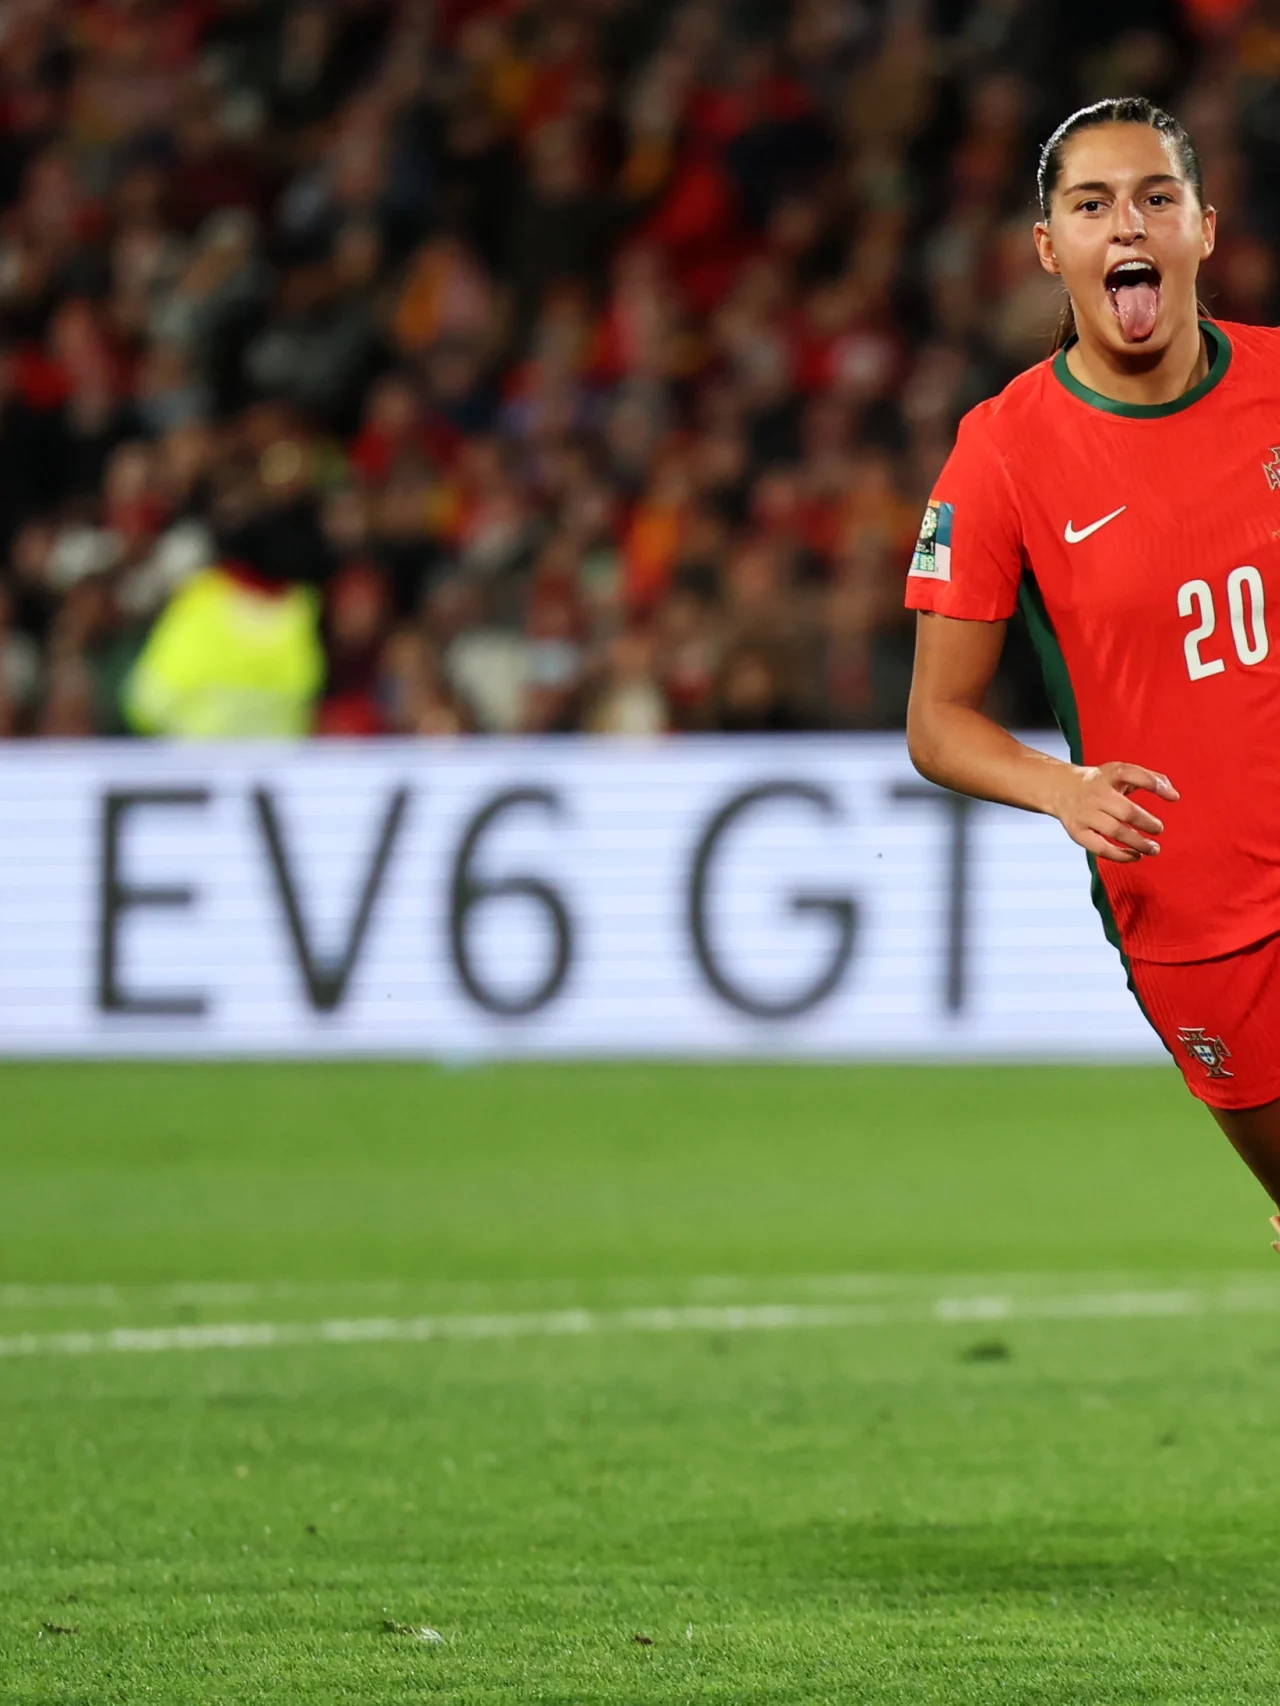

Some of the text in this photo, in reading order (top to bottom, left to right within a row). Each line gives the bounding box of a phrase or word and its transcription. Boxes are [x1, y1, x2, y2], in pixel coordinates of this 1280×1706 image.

[1177, 565, 1269, 681] 20
[96, 778, 982, 1020] EV6 GT
